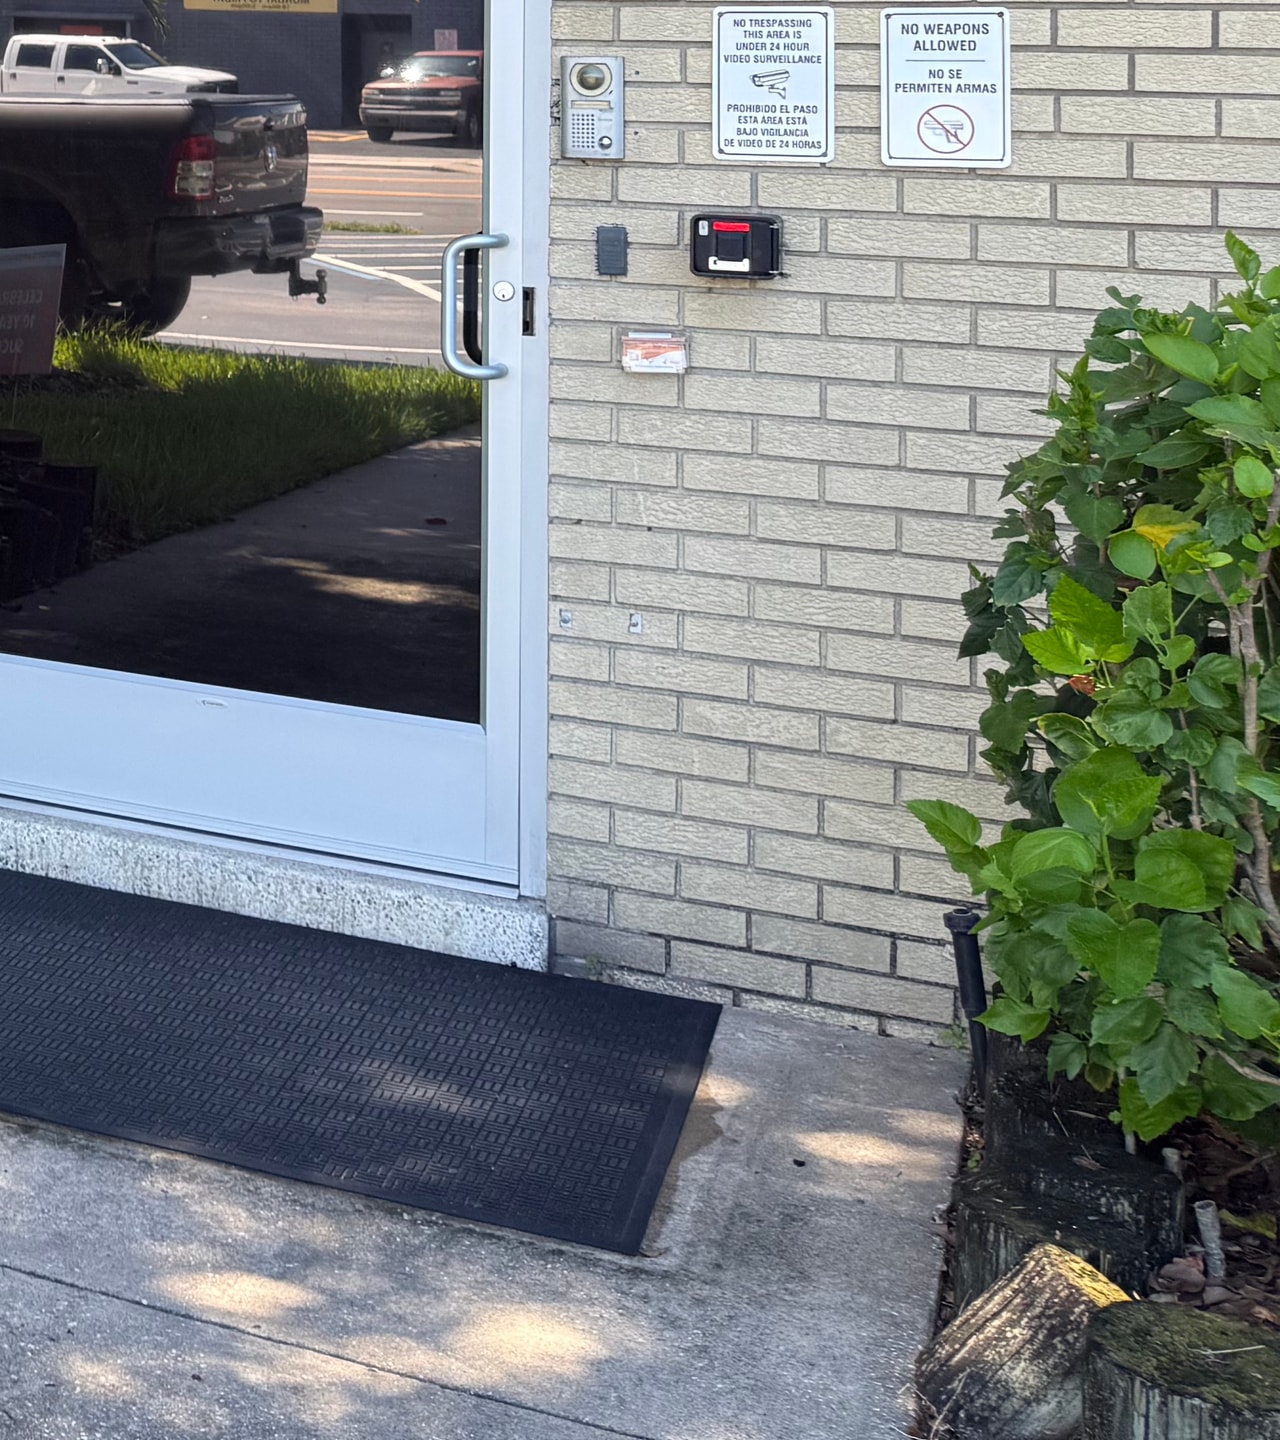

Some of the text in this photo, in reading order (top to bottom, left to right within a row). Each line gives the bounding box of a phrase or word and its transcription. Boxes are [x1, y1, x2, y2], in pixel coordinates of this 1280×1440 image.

[733, 19, 812, 28] NO TRESPASSING
[901, 23, 990, 35] NO WEAPONS
[743, 30, 802, 39] THIS AREA IS
[736, 42, 810, 51] UNDER 24 HOUR
[913, 40, 977, 51] ALLOWED
[723, 54, 822, 64] VIDEO SURVEILLANCE
[928, 69, 963, 79] NO SE
[895, 83, 998, 93] PERMITEN ARMAS
[726, 104, 818, 114] PROHIBIDO EL PASO
[737, 116, 759, 124] ESTA
[736, 127, 809, 137] BAJO VIGILANCIA
[724, 138, 822, 149] DE VIDEO DE 24 HORAS
